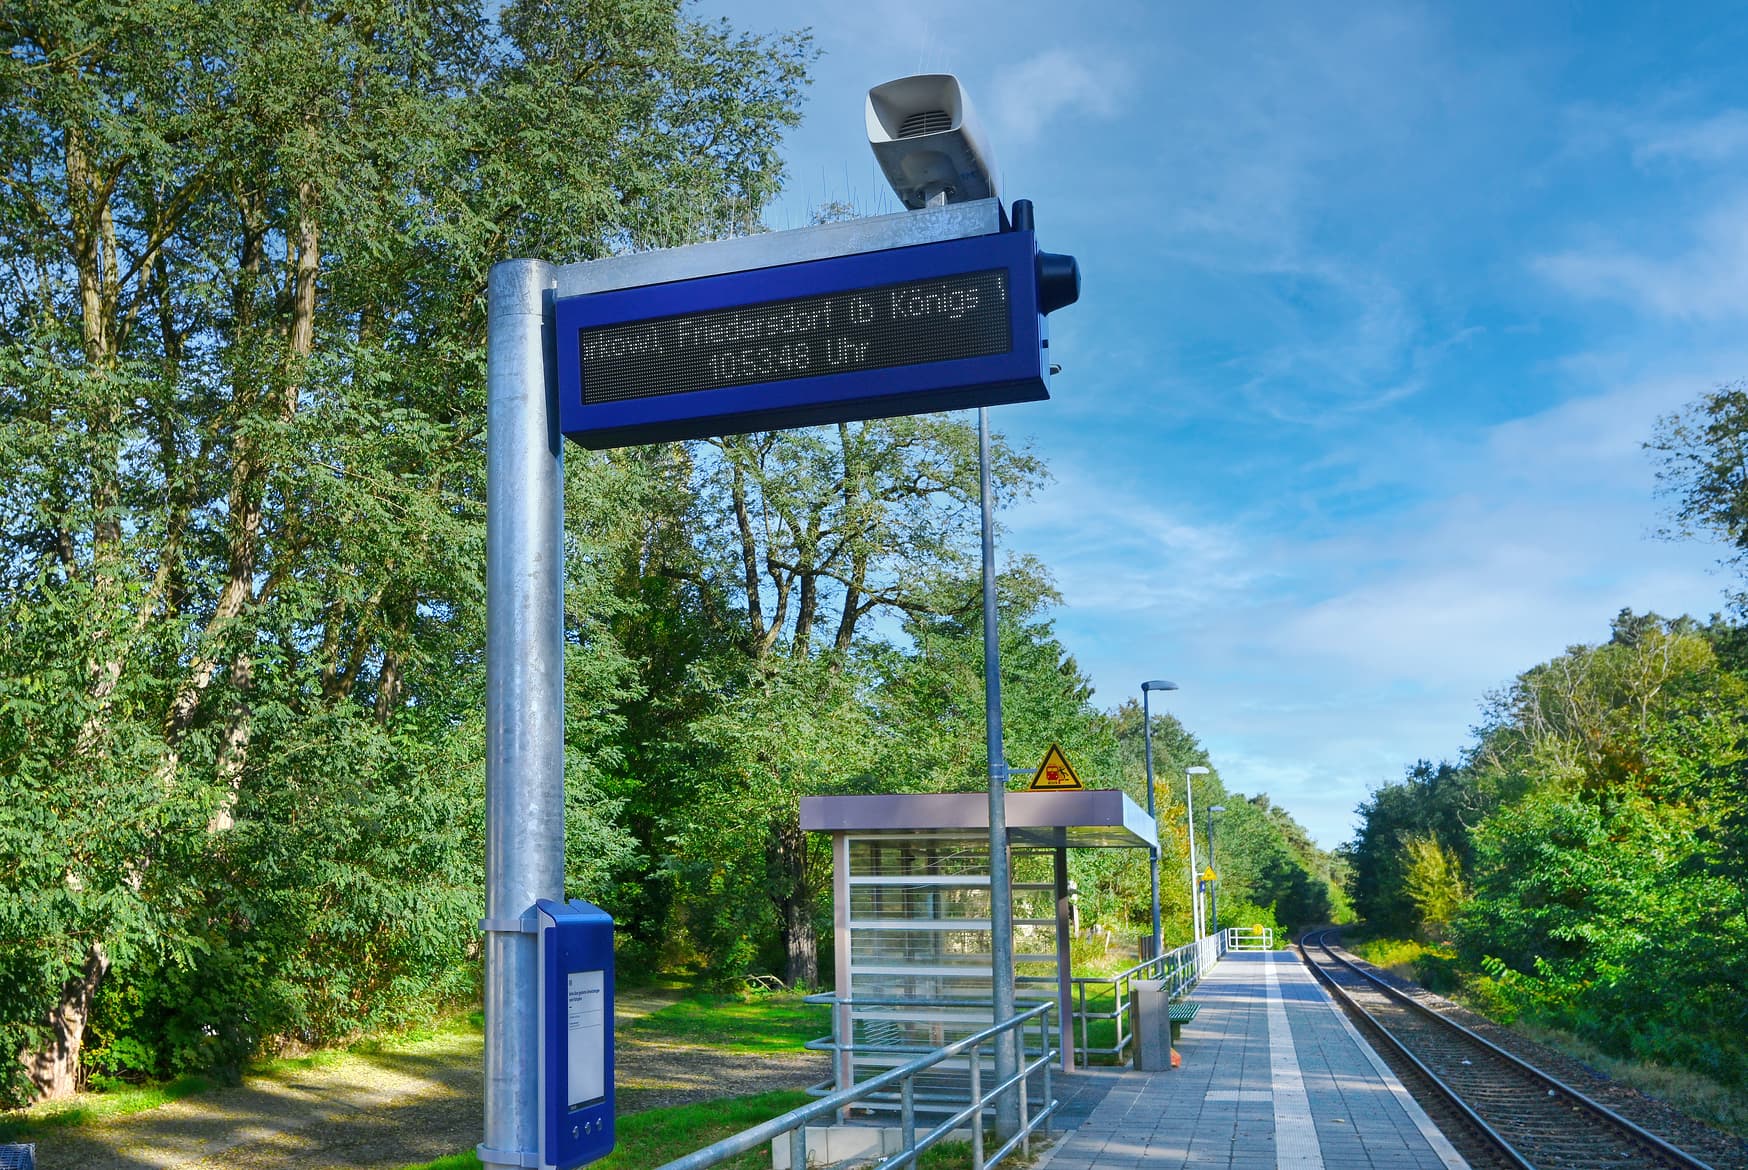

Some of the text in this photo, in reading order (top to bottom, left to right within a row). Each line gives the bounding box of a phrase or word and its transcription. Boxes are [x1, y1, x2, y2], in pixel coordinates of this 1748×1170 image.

[678, 301, 832, 347] Friedersdorf
[851, 297, 873, 323] (b
[892, 285, 979, 319] Königs
[709, 337, 869, 380] 10:53:48 Uhr
